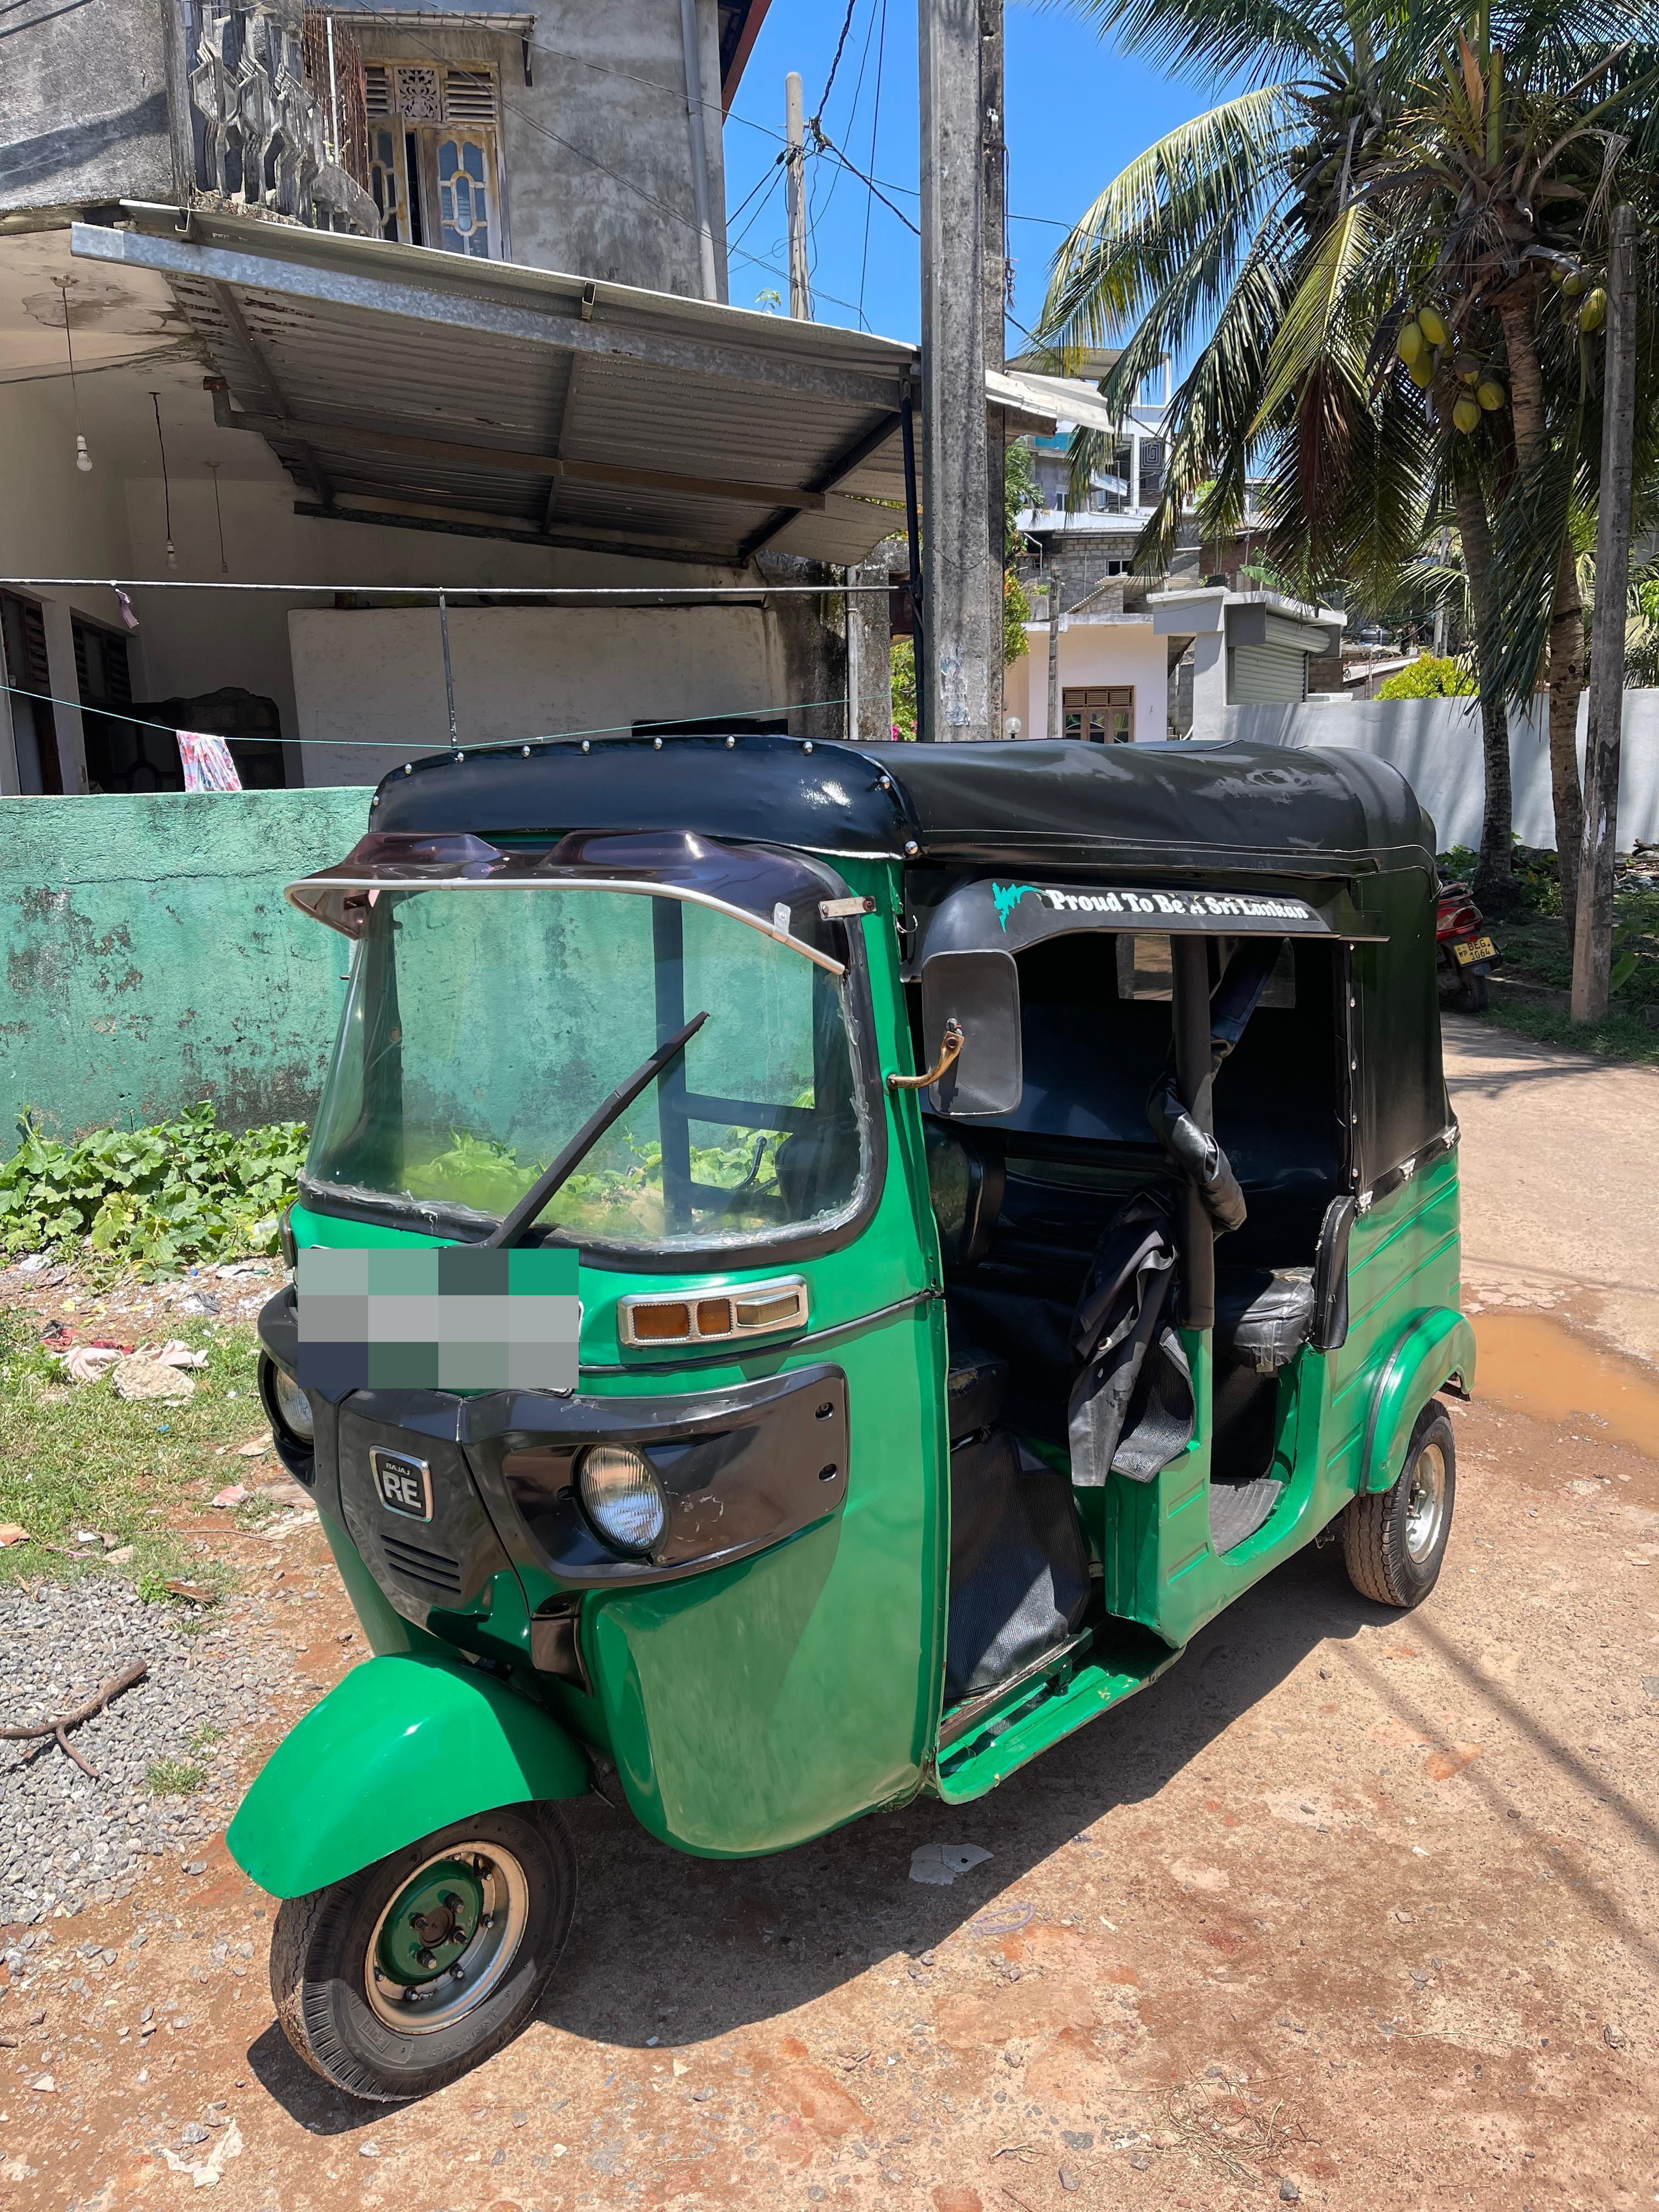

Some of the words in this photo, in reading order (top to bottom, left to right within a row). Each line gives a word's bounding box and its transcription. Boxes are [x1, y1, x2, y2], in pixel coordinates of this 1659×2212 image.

[1045, 889, 1124, 912] Proud
[1121, 893, 1154, 913] To
[1152, 894, 1186, 913] Be
[1204, 896, 1240, 915] Sri
[1235, 899, 1309, 919] Lankan
[1468, 939, 1487, 951] BEG
[1470, 948, 1491, 961] 1064
[386, 1462, 410, 1476] BAJAJ
[382, 1470, 422, 1508] RE
